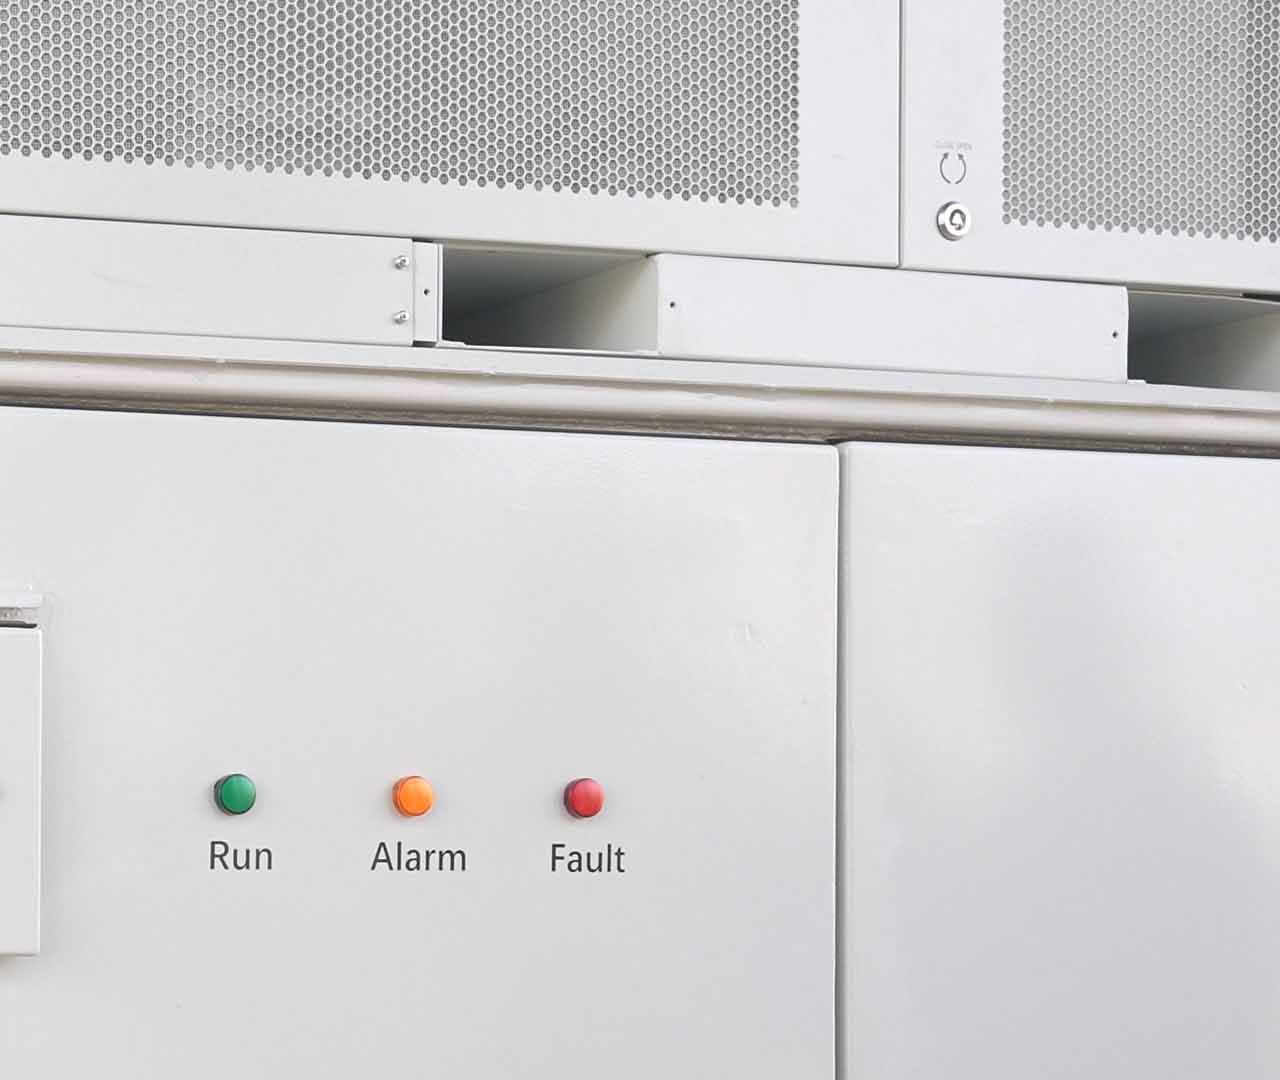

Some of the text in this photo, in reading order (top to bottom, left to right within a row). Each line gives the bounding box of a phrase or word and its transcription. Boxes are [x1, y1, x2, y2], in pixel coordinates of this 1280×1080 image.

[209, 840, 273, 871] Run
[370, 841, 467, 872] Alarm
[551, 843, 626, 873] Fault
